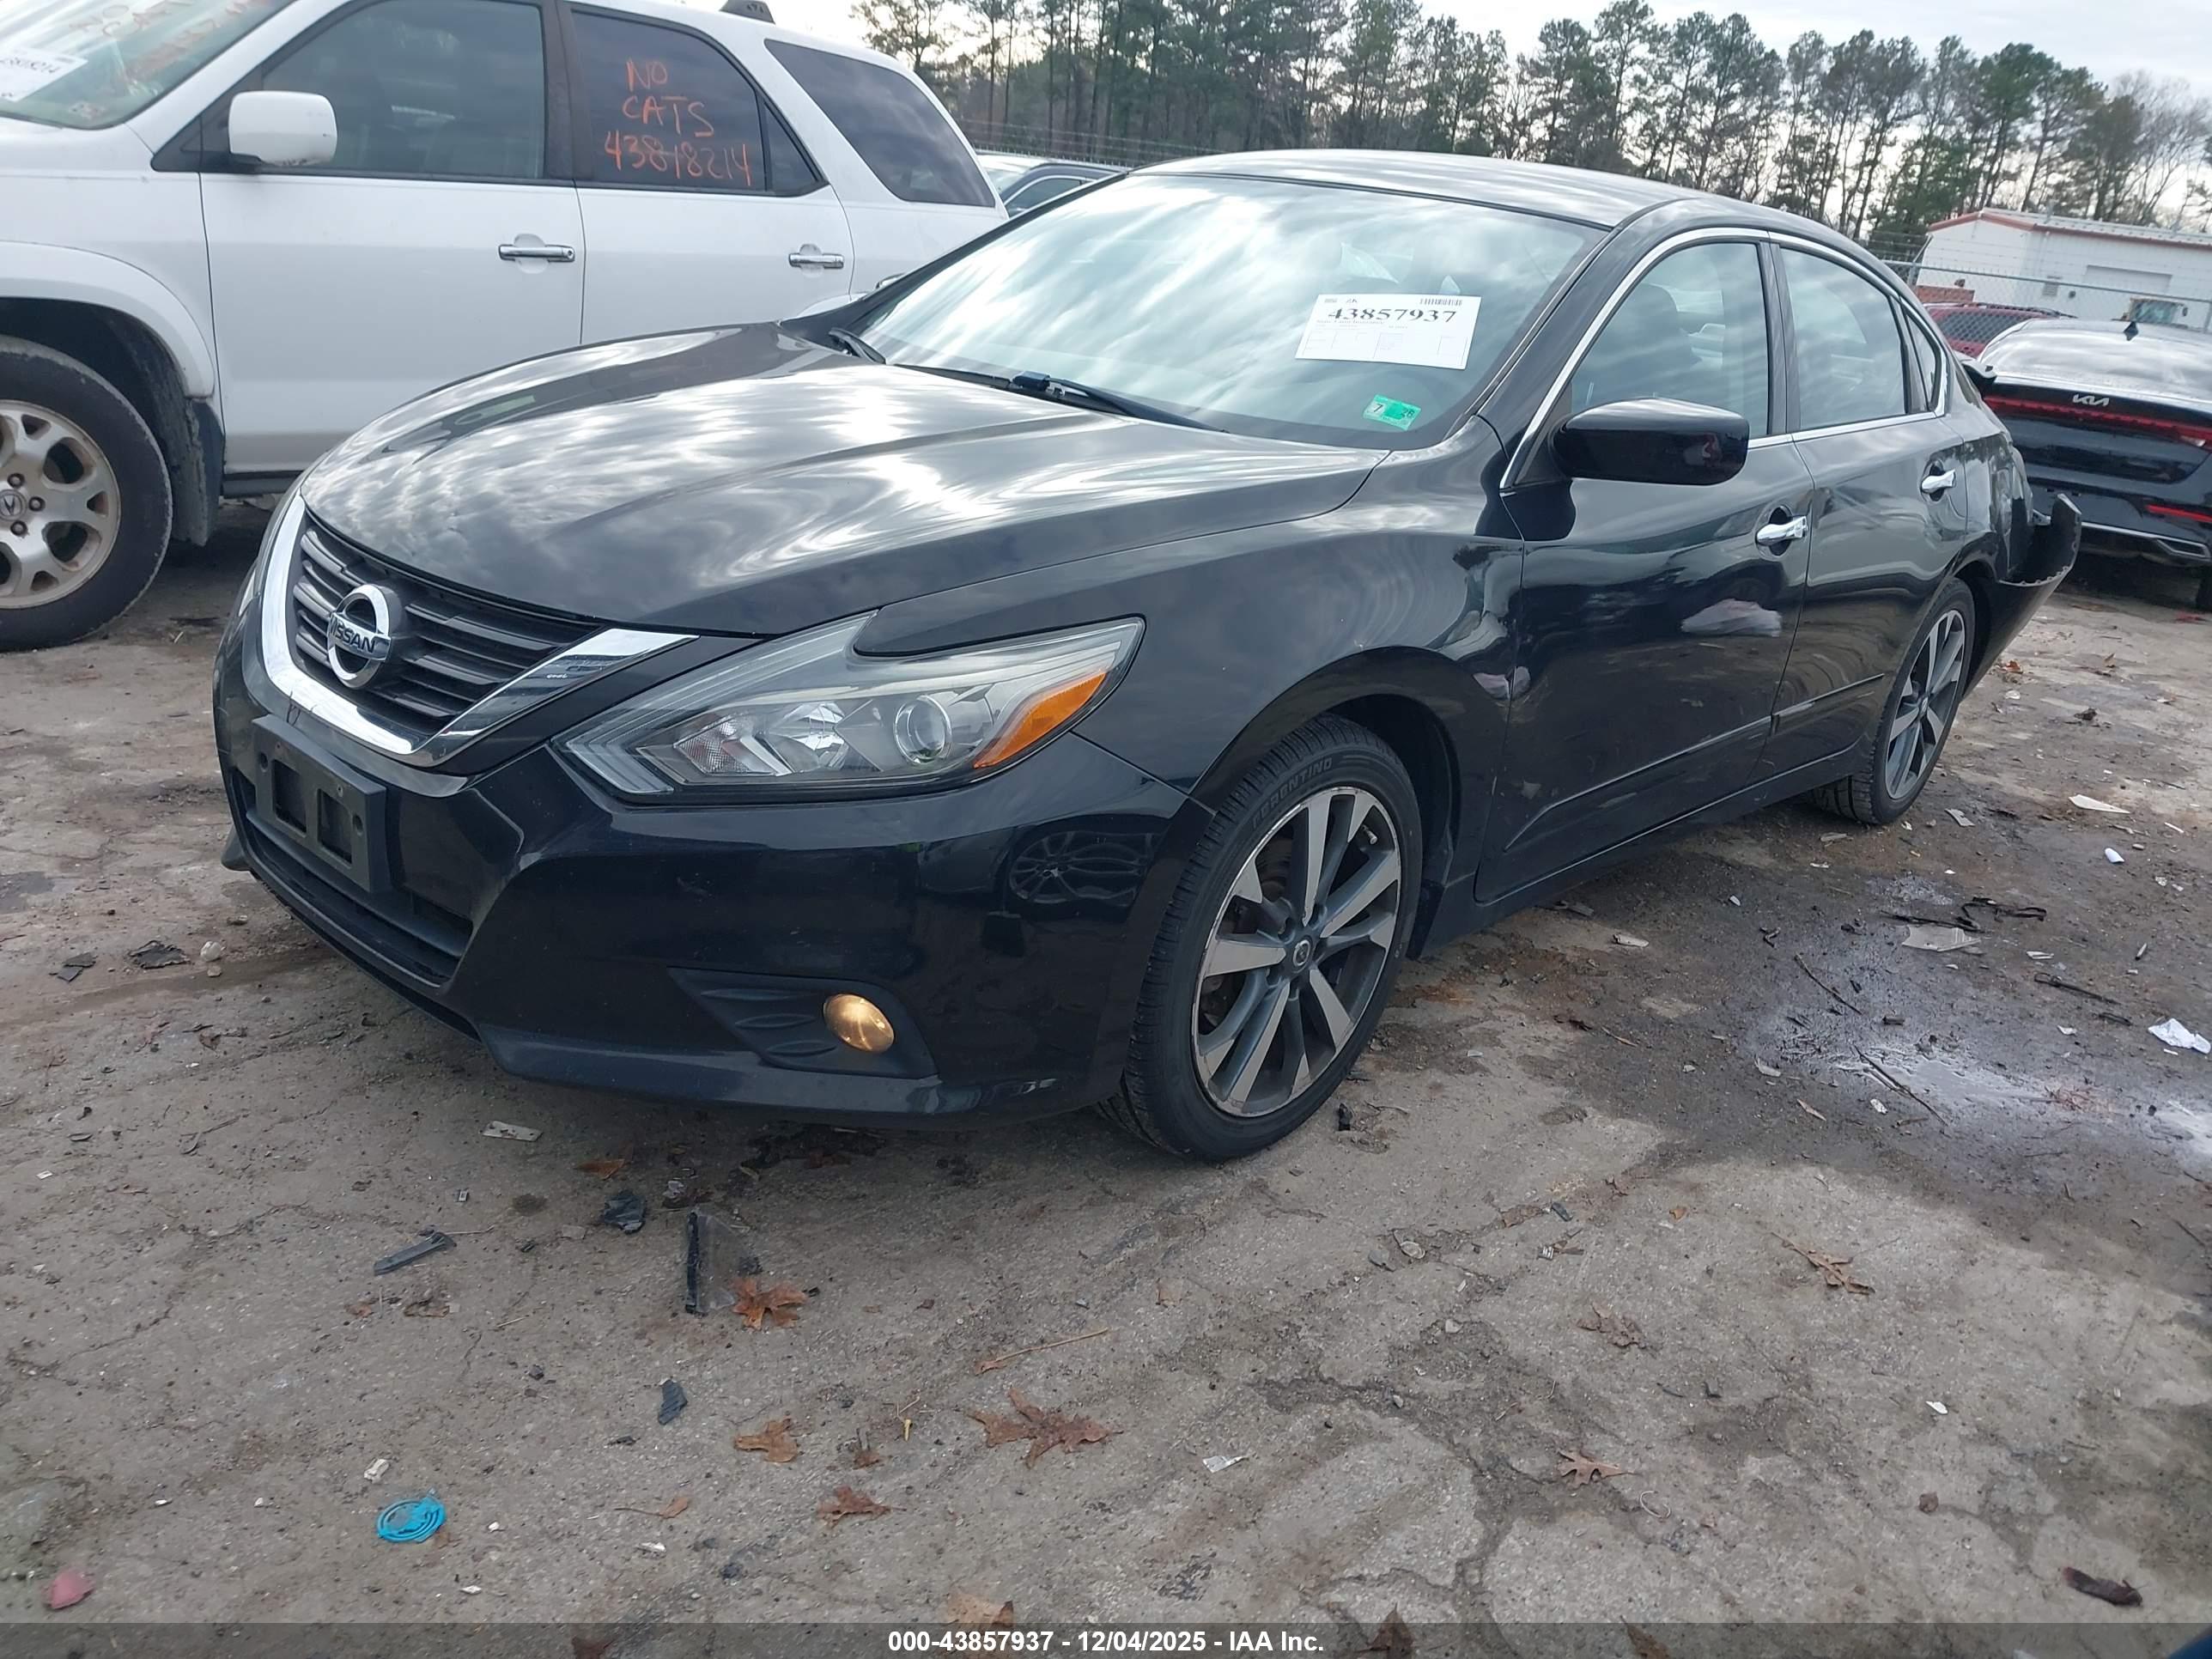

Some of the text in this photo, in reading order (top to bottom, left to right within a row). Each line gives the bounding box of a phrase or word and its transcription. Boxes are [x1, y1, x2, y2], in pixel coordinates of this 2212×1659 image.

[626, 57, 669, 93] NO
[622, 94, 715, 138] CATS
[604, 129, 751, 187] 43818214
[1328, 307, 1457, 323] 43857937
[330, 617, 376, 653] NISSAN
